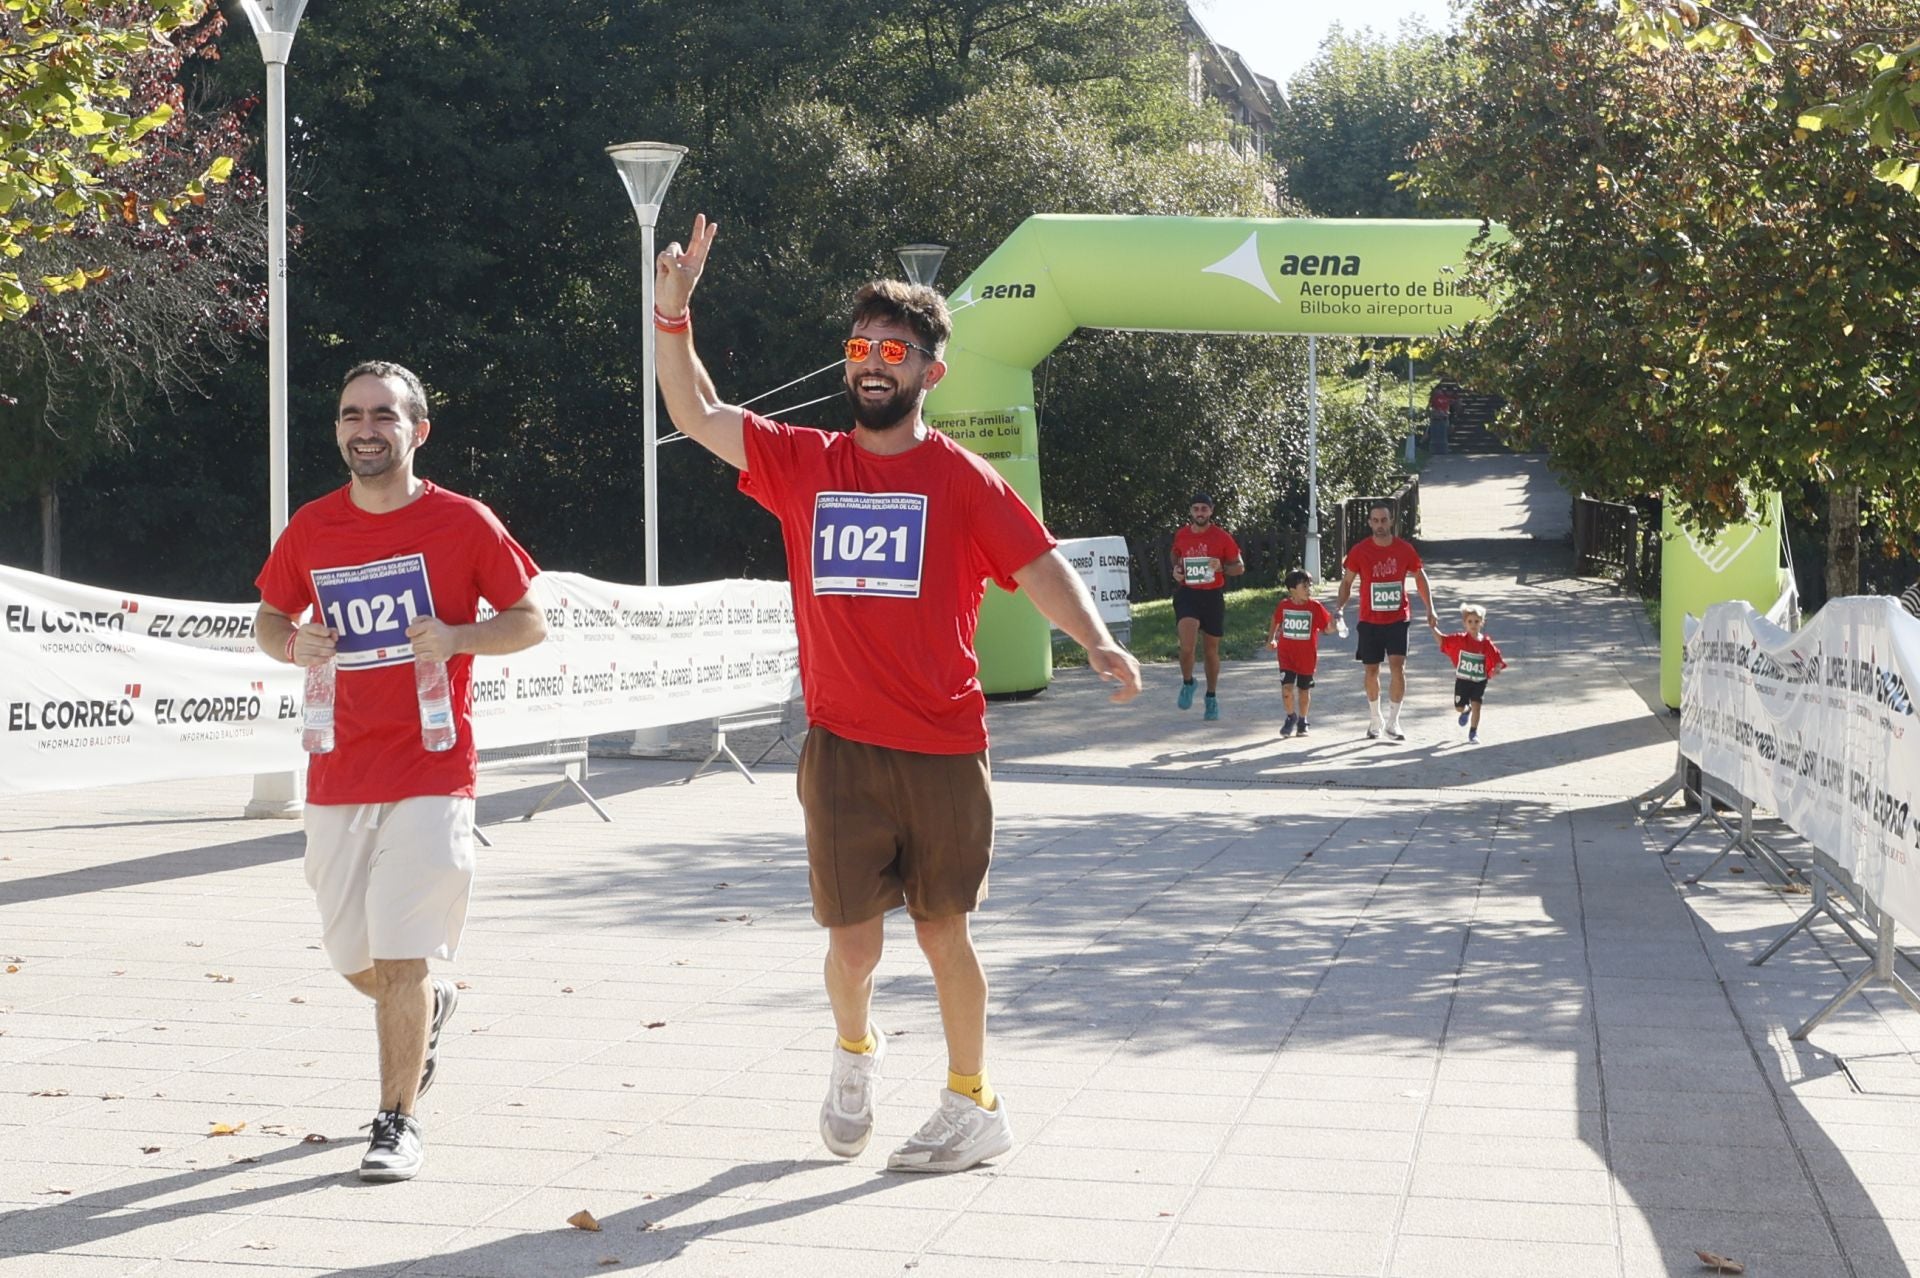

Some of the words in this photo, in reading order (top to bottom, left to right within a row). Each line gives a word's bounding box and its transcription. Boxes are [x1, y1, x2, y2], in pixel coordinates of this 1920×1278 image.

[1279, 254, 1361, 276] aena
[981, 283, 1036, 299] aena
[1300, 281, 1400, 299] Aeropuerto
[1405, 281, 1427, 297] de
[1433, 281, 1476, 298] Bil
[1300, 300, 1361, 315] Bilboko
[1366, 301, 1453, 317] aireportua
[931, 418, 966, 429] Carrera
[970, 415, 1015, 426] Familiar
[979, 427, 994, 438] de
[997, 426, 1020, 437] Loiu
[820, 524, 908, 563] 1021
[1099, 556, 1107, 567] EL
[1186, 565, 1209, 577] 204
[1101, 591, 1109, 602] EL
[1374, 590, 1401, 602] 2043
[6, 604, 35, 633] EL
[327, 589, 418, 637] 1021
[147, 614, 174, 639] EL
[1284, 618, 1309, 631] 2002
[40, 640, 93, 653] INFORMACIÓN
[94, 642, 112, 654] CON
[1460, 659, 1485, 674] 2043
[472, 679, 506, 703] ORREO
[9, 701, 37, 732] EL
[41, 698, 135, 730] CORREO
[154, 698, 177, 725] EL
[180, 695, 261, 724] CORREO
[278, 694, 297, 720] EL
[38, 737, 88, 750] INFORMAZIO
[89, 734, 132, 747] BALIOTSUA
